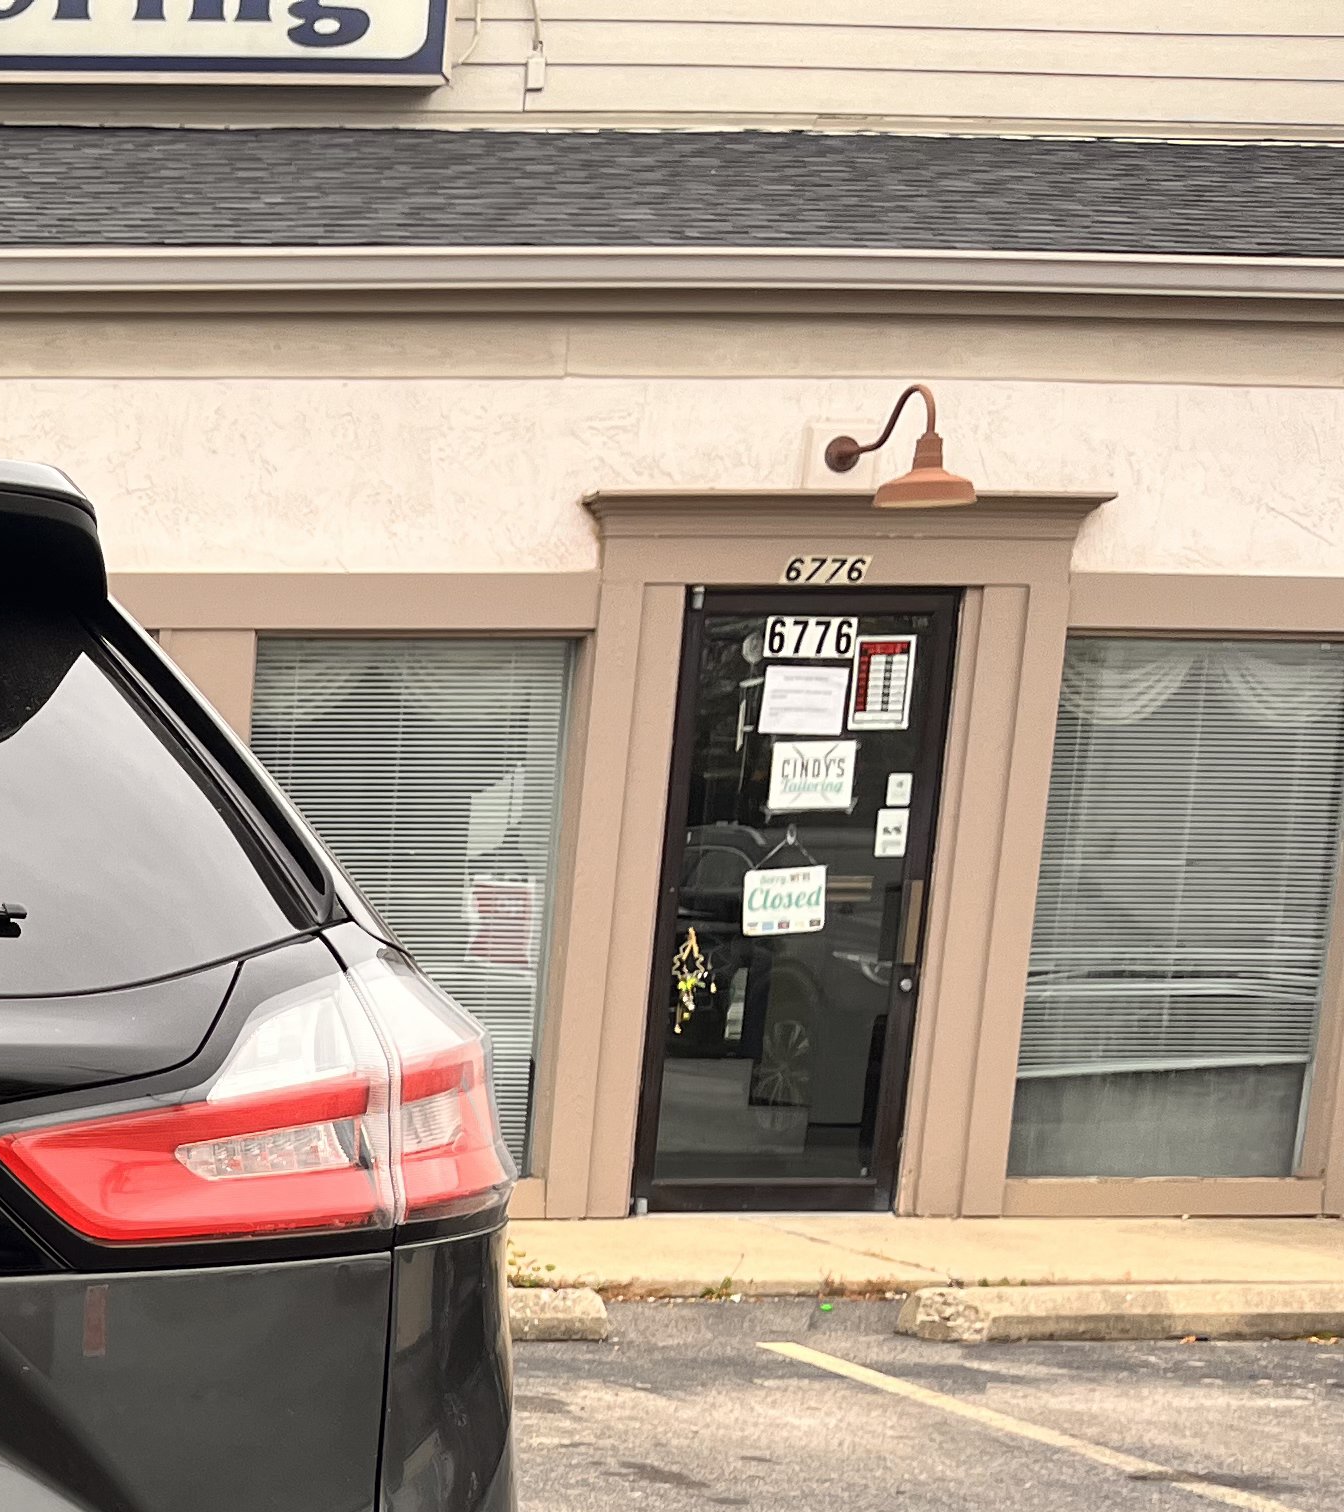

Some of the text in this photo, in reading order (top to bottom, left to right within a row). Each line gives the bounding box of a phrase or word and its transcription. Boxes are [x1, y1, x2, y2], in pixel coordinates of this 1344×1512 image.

[785, 557, 867, 583] 6776
[768, 619, 853, 655] 6776
[747, 885, 822, 912] Closed
